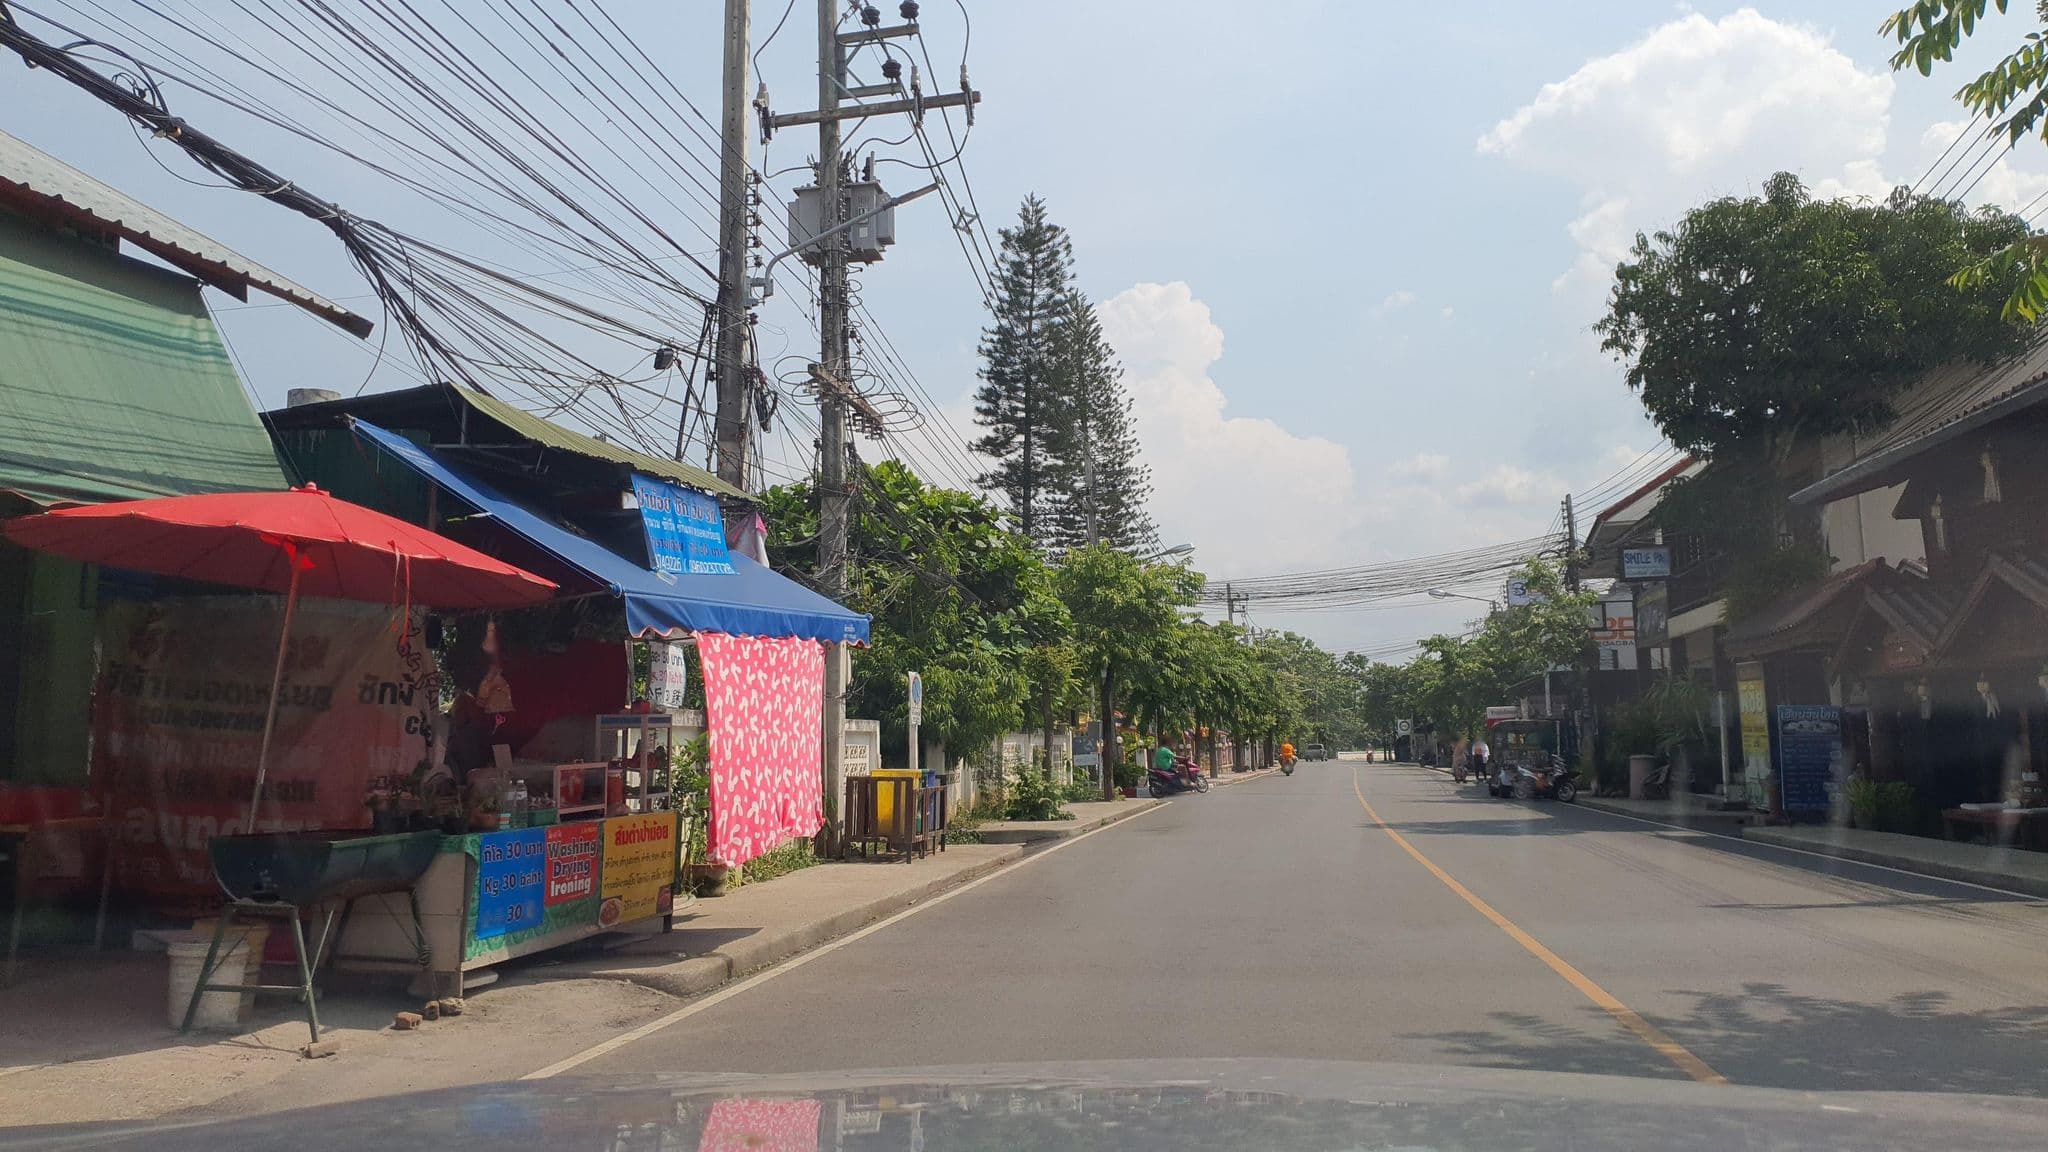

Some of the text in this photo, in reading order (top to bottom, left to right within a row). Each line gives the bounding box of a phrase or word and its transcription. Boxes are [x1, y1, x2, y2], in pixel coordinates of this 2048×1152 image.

[506, 842, 522, 860] 30
[547, 837, 597, 860] Washing
[553, 857, 592, 880] Drying
[485, 876, 500, 897] Kg
[502, 873, 518, 891] 30
[550, 875, 592, 897] Ironing
[506, 904, 522, 922] 30
